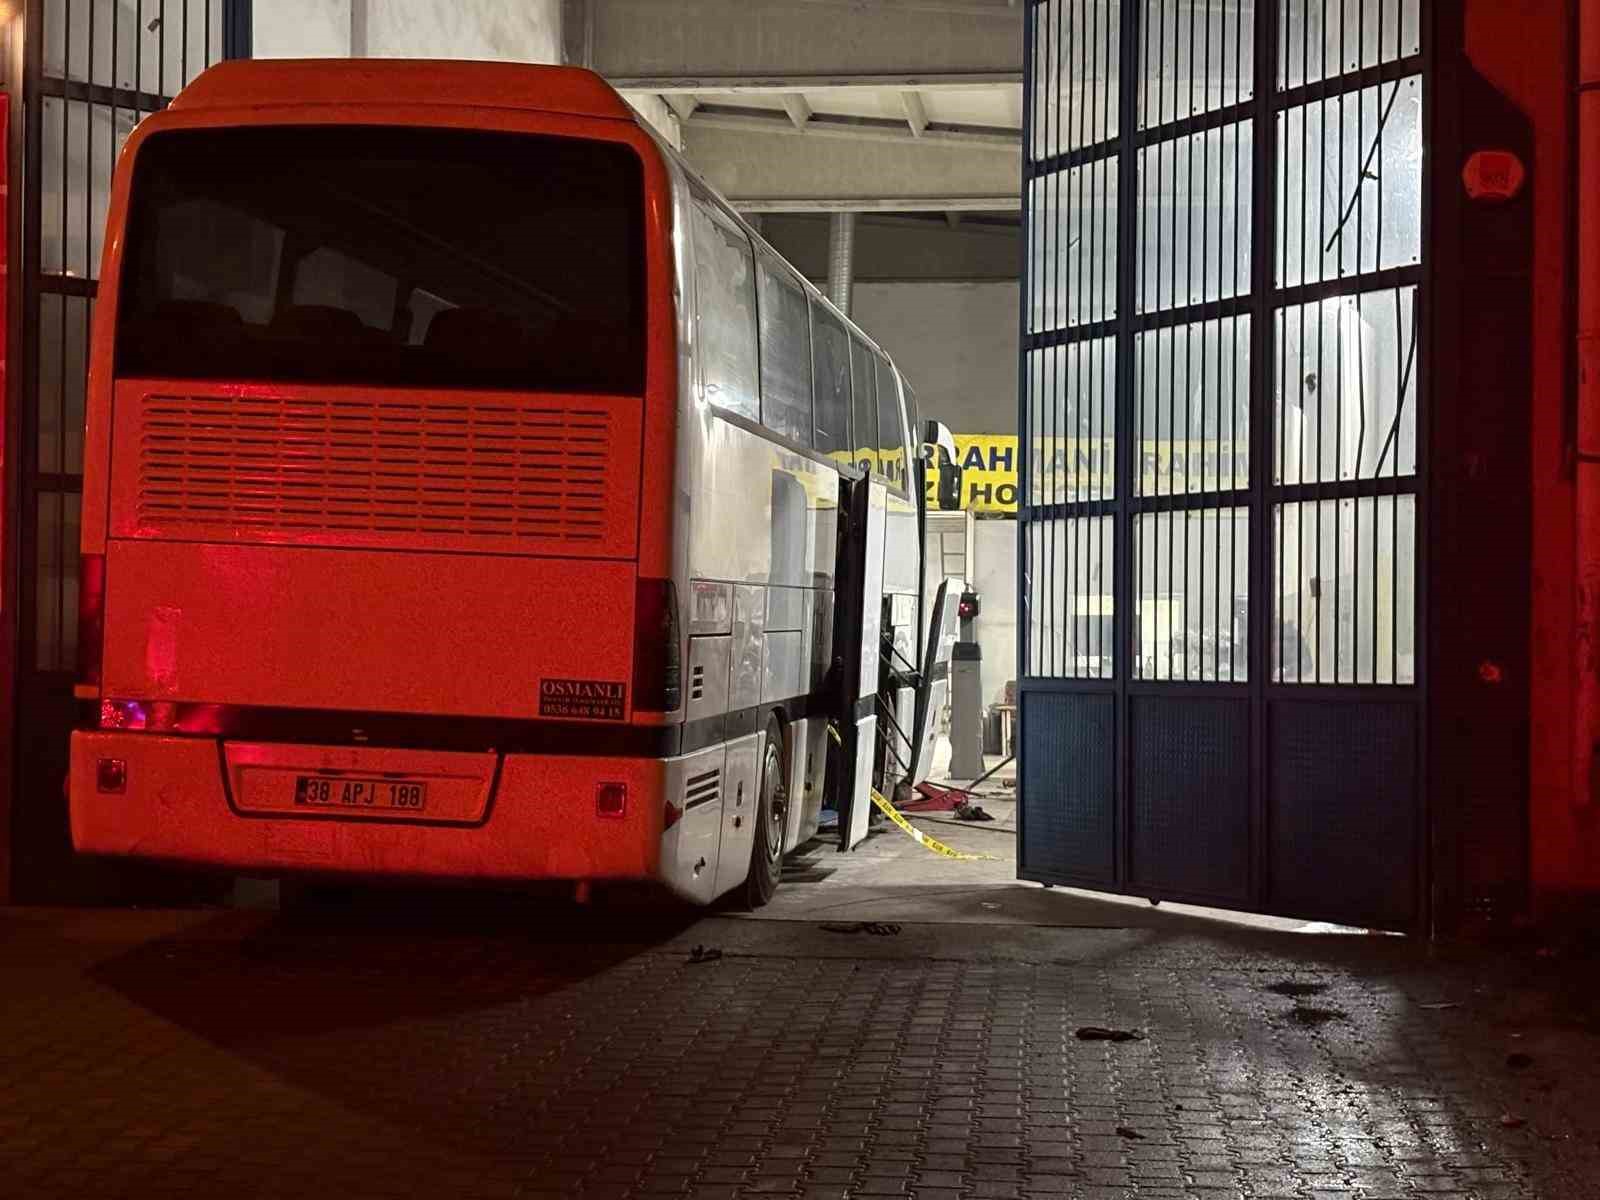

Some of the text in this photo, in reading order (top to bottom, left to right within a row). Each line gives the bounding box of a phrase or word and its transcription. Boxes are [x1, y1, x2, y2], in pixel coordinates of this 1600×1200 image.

[542, 681, 623, 699] OSMANLI
[308, 781, 330, 801] 38
[342, 783, 376, 804] APJ
